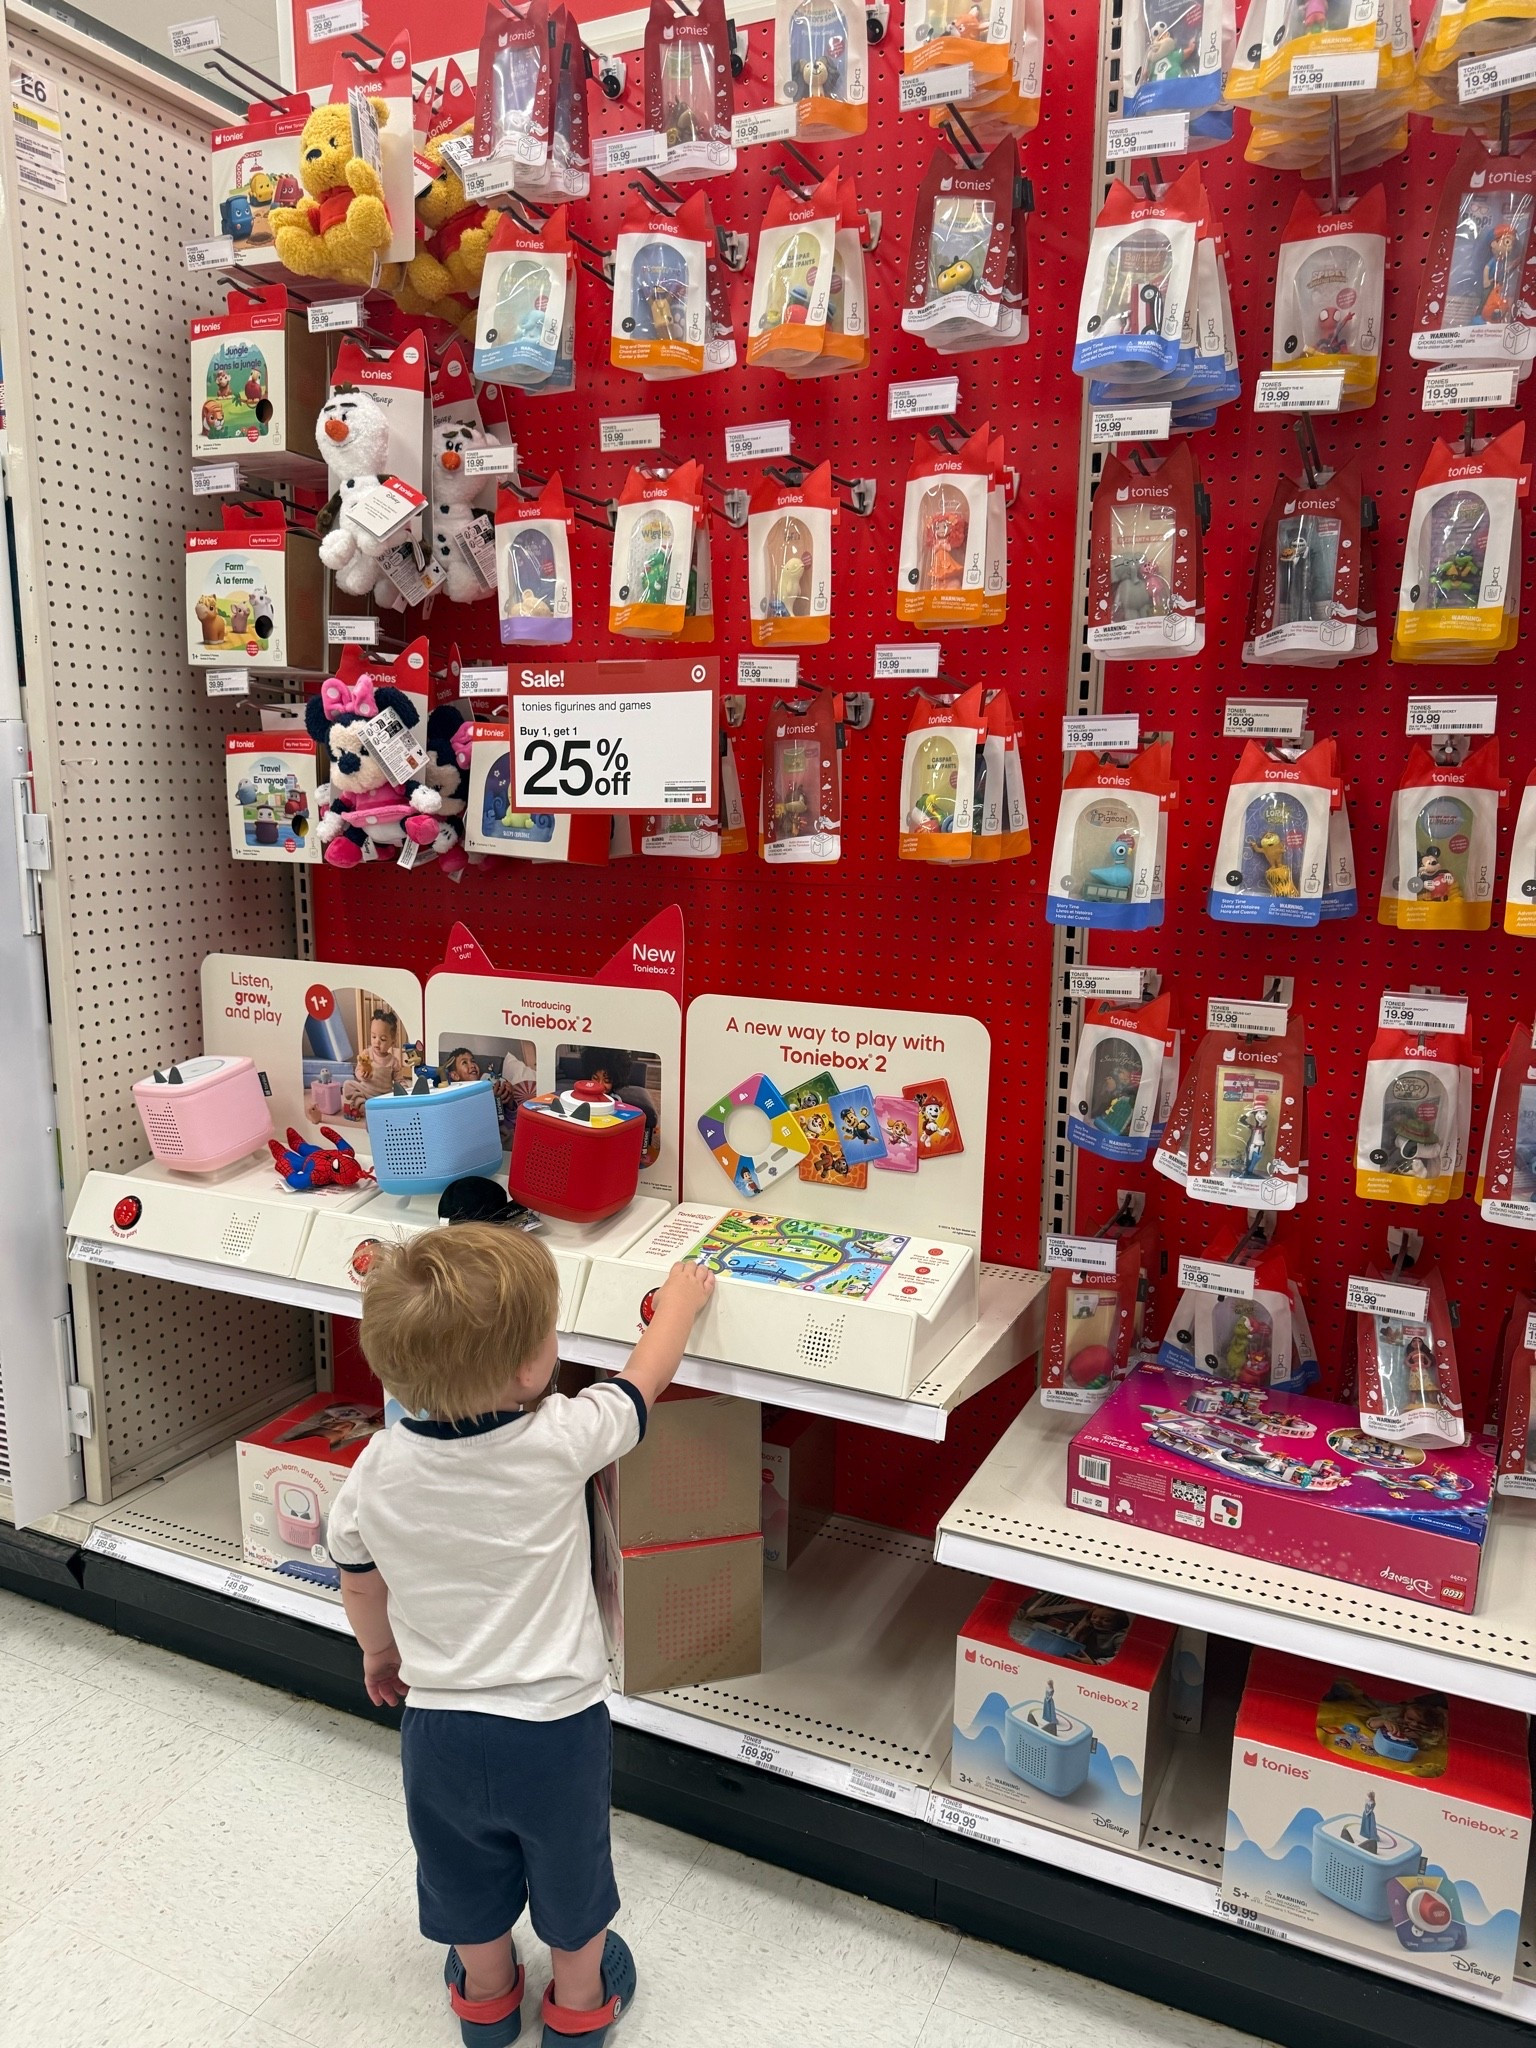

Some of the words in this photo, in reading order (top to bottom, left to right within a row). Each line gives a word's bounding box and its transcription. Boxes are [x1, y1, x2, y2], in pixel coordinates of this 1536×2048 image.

[314, 21, 332, 32] 29.99
[676, 26, 708, 36] tonies
[174, 37, 190, 47] 39.99
[1463, 64, 1487, 73] TONIES
[1293, 73, 1323, 84] 19.99
[1464, 71, 1498, 88] 19.99
[21, 73, 46, 102] E6
[902, 86, 927, 99] 19.99
[223, 133, 243, 142] tonies
[736, 126, 758, 138] 19.99
[1108, 128, 1128, 136] TONIES
[1109, 136, 1137, 149] 19.99
[609, 151, 630, 162] 19.99
[1488, 171, 1532, 184] tonies
[955, 179, 991, 191] tonies
[1131, 208, 1165, 220] tonies
[1317, 221, 1353, 234] tonies
[188, 254, 205, 263] 39.99
[311, 316, 328, 324] 29.99
[202, 322, 221, 332] tonies
[224, 346, 249, 357] Jungle
[214, 362, 231, 371] Dans
[240, 359, 262, 371] jungle
[361, 370, 392, 380] tonies
[1261, 391, 1290, 401] 19.99
[1426, 388, 1458, 400] 19.99
[894, 399, 917, 409] 19.99
[1095, 422, 1122, 432] 19.99
[603, 433, 624, 442] 19.99
[730, 442, 752, 452] 19.99
[1448, 464, 1483, 477] tonies
[194, 479, 210, 487] 39.99
[1131, 486, 1169, 498] tonies
[1297, 499, 1336, 509] tonies
[197, 537, 218, 546] tonies
[225, 562, 244, 571] Farm
[216, 574, 222, 585] À
[224, 576, 230, 585] la
[232, 576, 253, 585] ferme
[329, 628, 346, 636] 30.99
[521, 670, 564, 688] Sale!
[740, 670, 761, 678] 19.99
[209, 680, 224, 688] 39.99
[462, 681, 478, 689] 39.99
[522, 701, 552, 712] tonies
[555, 701, 596, 713] figurines
[599, 701, 616, 711] and
[620, 701, 651, 713] games
[1227, 717, 1255, 726] 19.99
[1410, 714, 1440, 724] 19.99
[520, 727, 539, 737] Buy
[542, 727, 551, 737] 1,
[554, 728, 570, 737] get
[572, 727, 578, 735] 1
[786, 724, 815, 735] tonies
[1068, 732, 1094, 742] 19.99
[260, 764, 281, 773] Travel
[1097, 775, 1130, 786] tonies
[1265, 770, 1298, 780] tonies
[1432, 773, 1464, 783] tonies
[254, 776, 262, 784] En
[264, 776, 288, 787] voyage
[595, 772, 631, 796] off
[1098, 813, 1128, 824] Pigeon!
[452, 944, 464, 955] Try
[463, 942, 474, 950] me
[632, 943, 677, 964] New
[458, 952, 472, 961] out!
[633, 964, 668, 975] Toniebox
[669, 966, 676, 975] 2
[231, 972, 274, 990] Listen,
[1072, 980, 1096, 989] 19.99
[235, 992, 271, 1008] grow,
[311, 994, 328, 1011] 1+
[521, 999, 571, 1013] Introducing
[226, 1006, 250, 1020] and
[254, 1007, 282, 1027] play
[1210, 1013, 1238, 1023] 19.99
[1384, 1010, 1414, 1020] 19.99
[502, 1009, 577, 1032] Toniebox
[582, 1017, 592, 1033] 2
[1110, 1015, 1138, 1029] tonies
[726, 1017, 739, 1033] A
[745, 1022, 782, 1037] new
[787, 1026, 826, 1046] way
[831, 1027, 850, 1043] to
[856, 1030, 897, 1052] play
[903, 1034, 945, 1052] with
[1238, 1052, 1278, 1063] tonies
[1404, 1047, 1436, 1058] tonies
[780, 1046, 869, 1071] Toniebox
[875, 1055, 887, 1073] 2
[1501, 1202, 1530, 1211] WARNING:
[110, 1224, 120, 1238] Press
[127, 1229, 138, 1239] play
[80, 1246, 102, 1255] DISPLAY
[1049, 1247, 1073, 1257] 19.99
[1086, 1274, 1117, 1283] tonies
[1183, 1272, 1209, 1283] 19.99
[1349, 1293, 1377, 1305] 19.99
[1084, 1435, 1140, 1453] PRINCESS
[264, 1465, 282, 1480] Listen,
[282, 1464, 300, 1473] learn,
[301, 1468, 314, 1479] and
[312, 1477, 329, 1495] play!
[94, 1538, 117, 1551] 169.99
[223, 1580, 248, 1593] 149.99
[1380, 1566, 1436, 1599] Disney
[1442, 1588, 1464, 1600] LEGO
[980, 1654, 1019, 1675] tonies
[1077, 1686, 1128, 1709] Toniebox
[1131, 1702, 1139, 1711] 2
[740, 1745, 773, 1763] 169.99
[1262, 1757, 1310, 1780] tonies
[960, 1773, 973, 1784] 3+
[940, 1809, 977, 1829] 149.99
[1092, 1812, 1129, 1837] Disney
[1442, 1809, 1506, 1837] Toniebox
[1510, 1829, 1519, 1840] 2
[1233, 1887, 1250, 1900] 5+
[1215, 1898, 1258, 1922] 169.99
[1451, 1955, 1501, 1984] Disney
